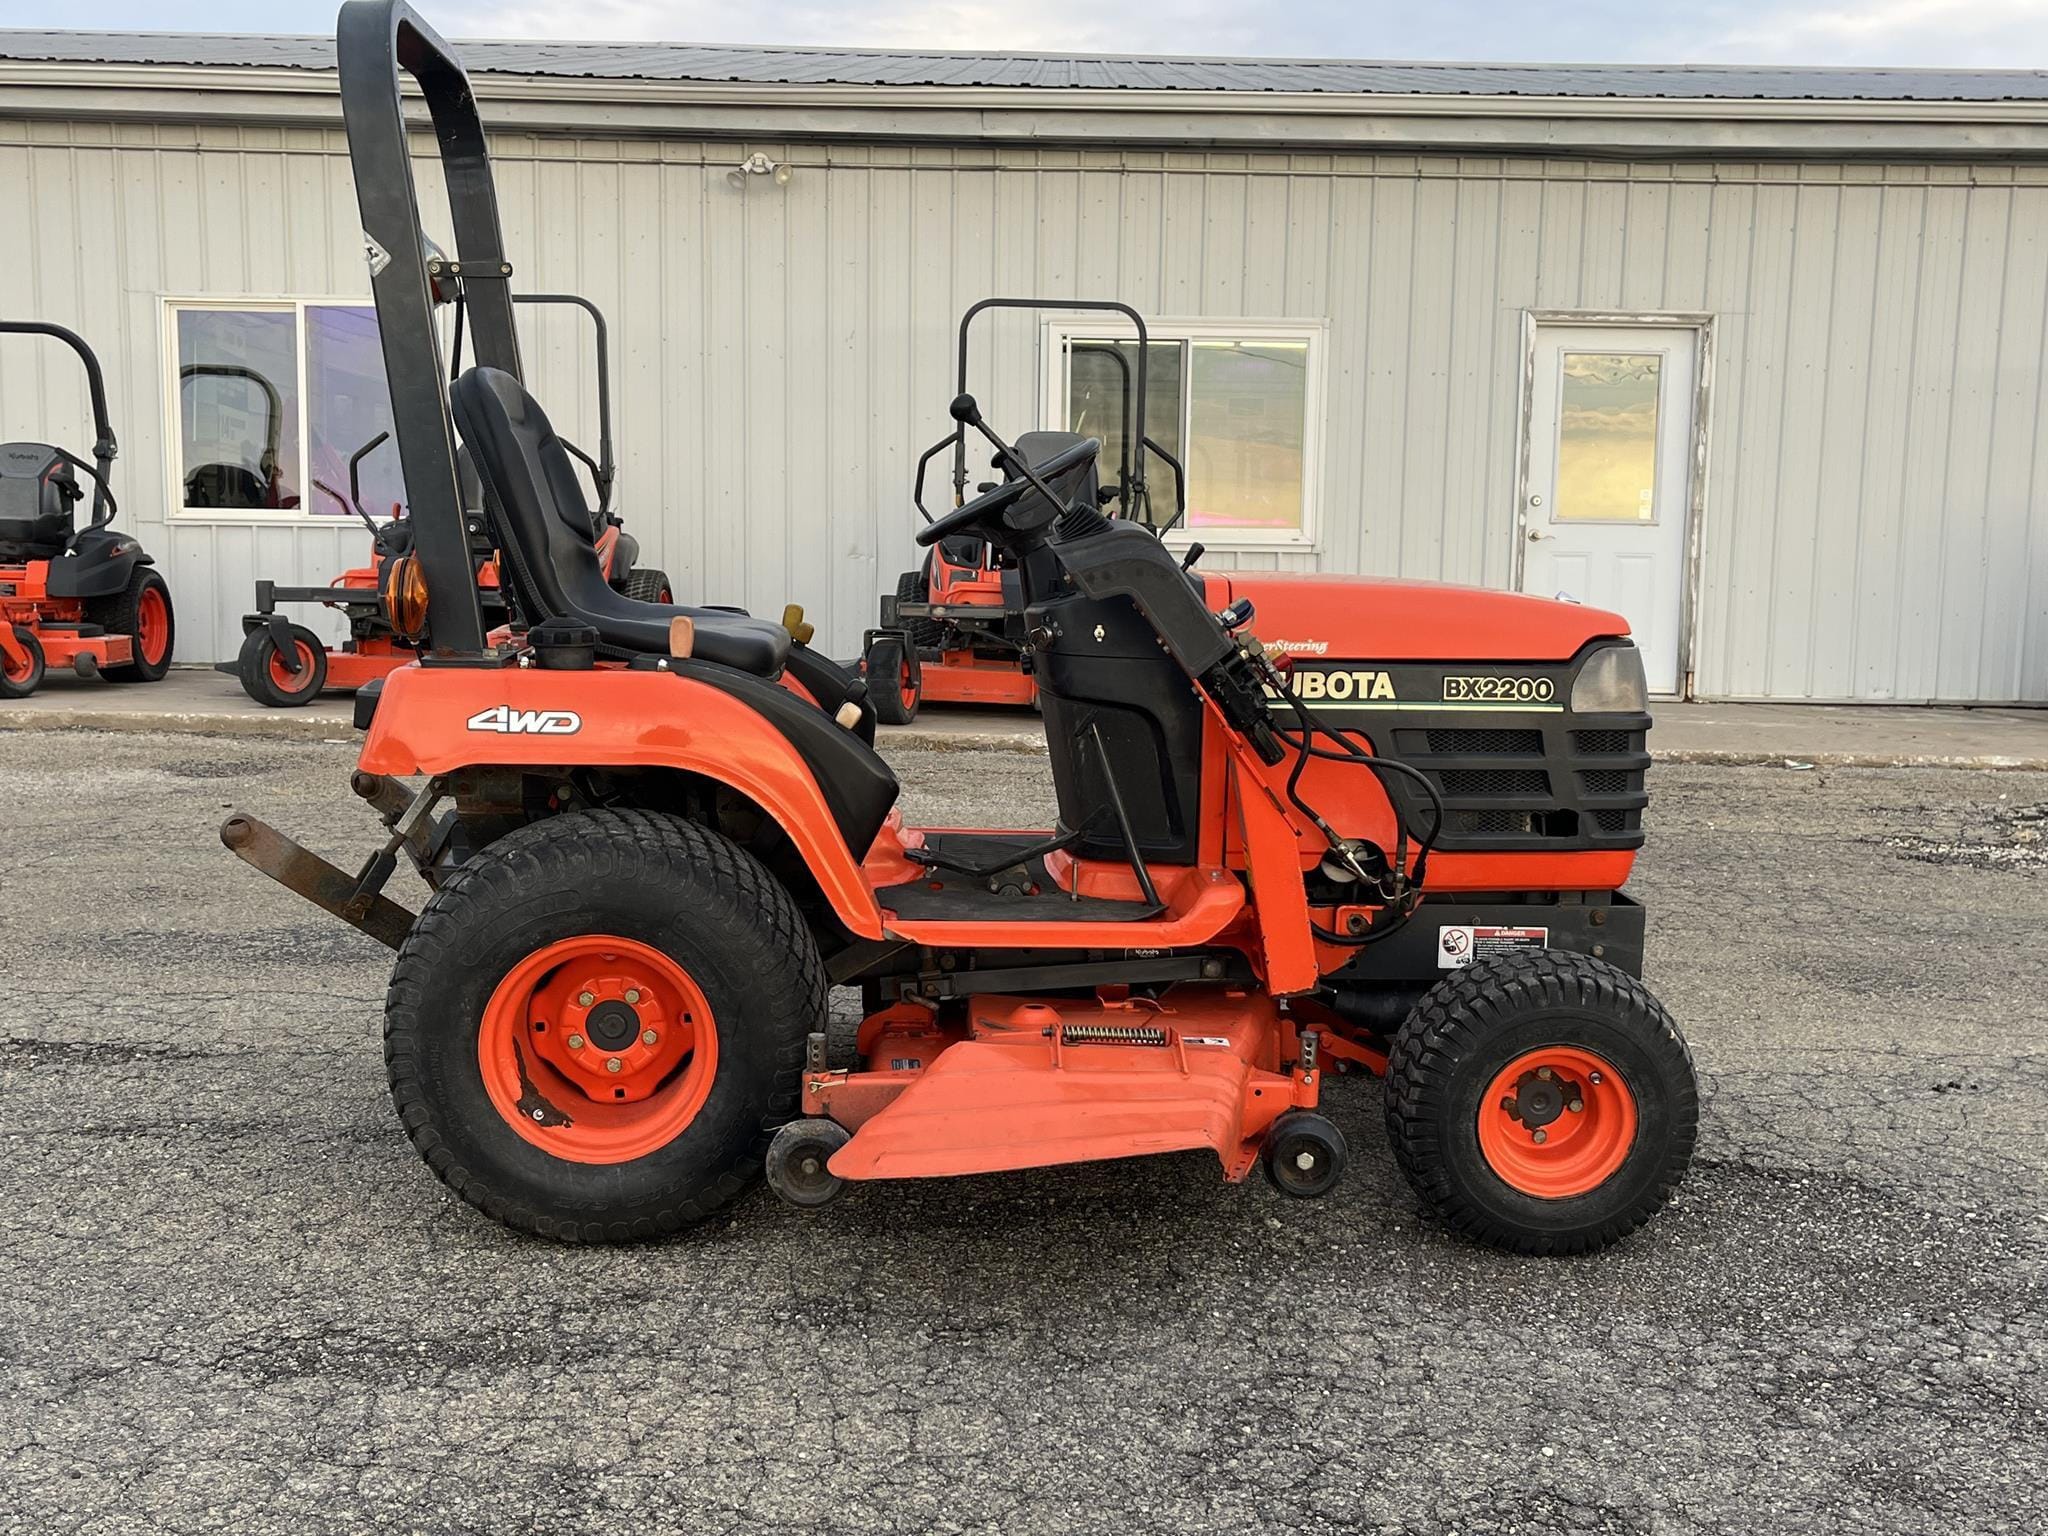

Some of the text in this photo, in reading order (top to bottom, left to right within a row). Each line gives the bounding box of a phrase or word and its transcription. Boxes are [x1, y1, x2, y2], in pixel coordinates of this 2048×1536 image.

[1262, 639, 1329, 654] erSteering
[1261, 671, 1396, 699] UBOTA
[1443, 677, 1554, 701] BX2200
[467, 705, 582, 735] 4WD
